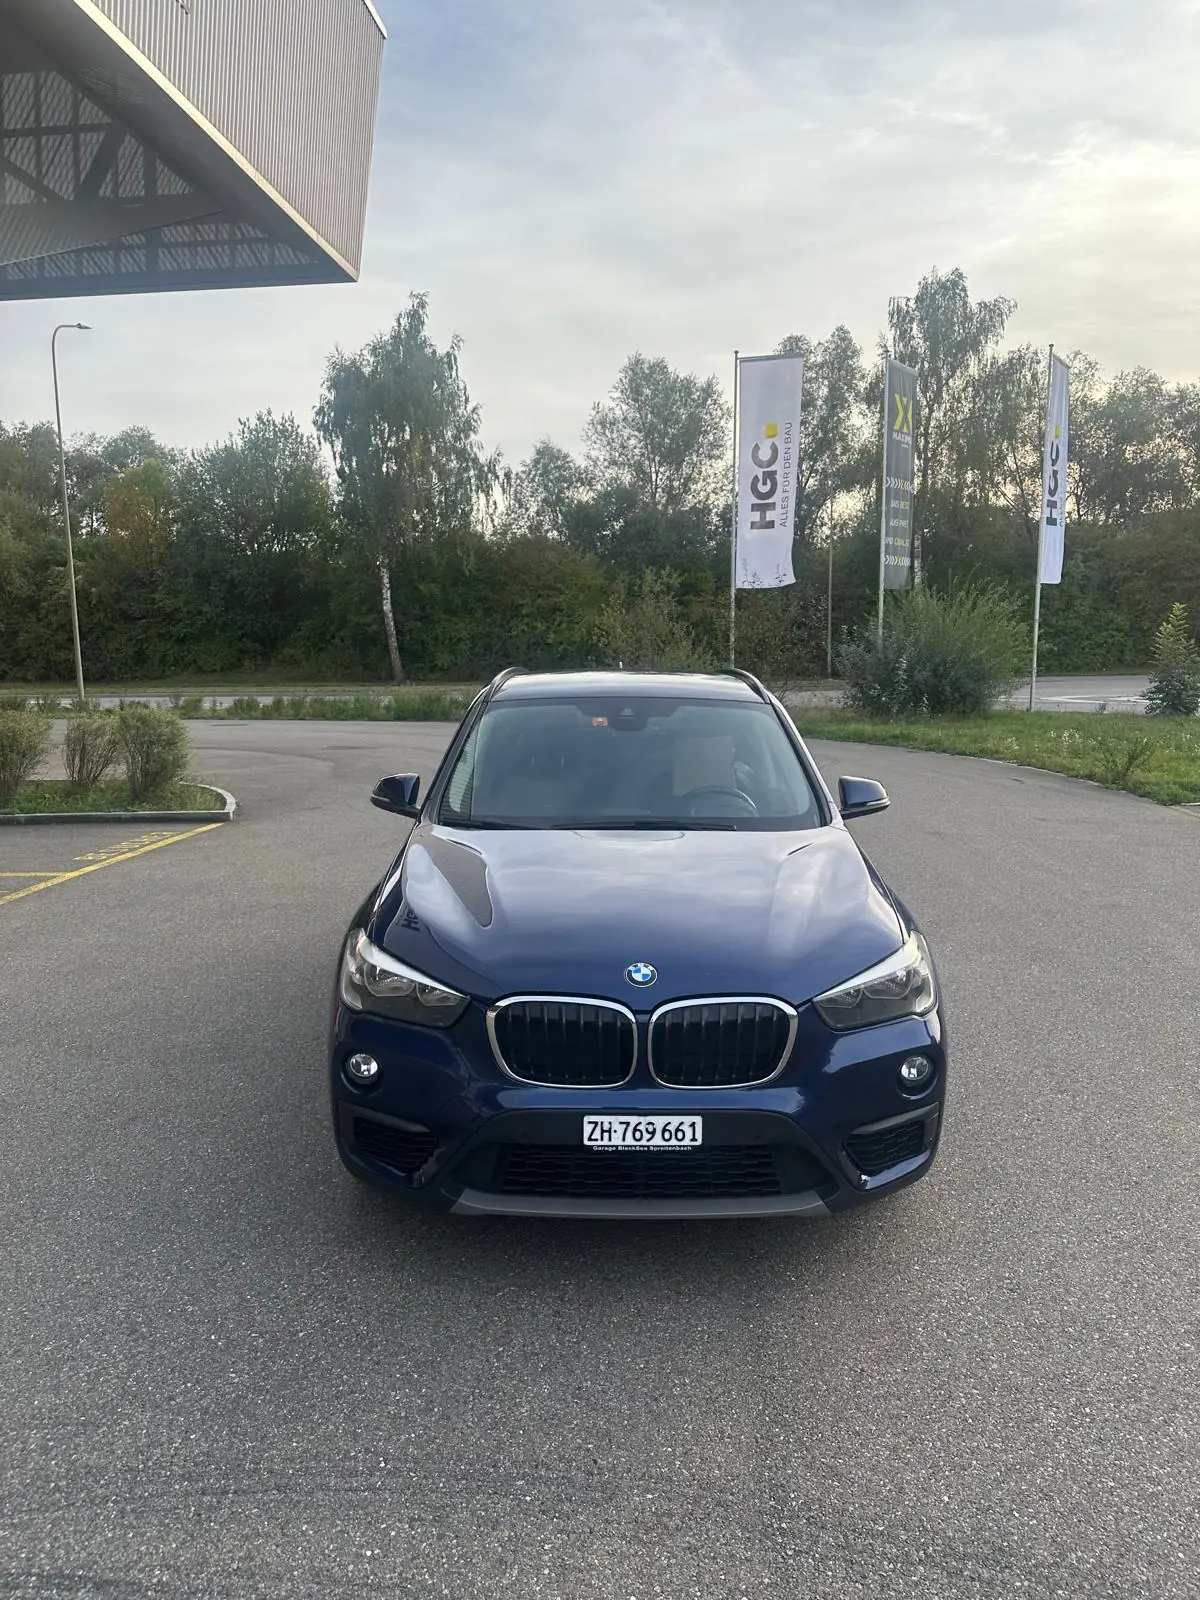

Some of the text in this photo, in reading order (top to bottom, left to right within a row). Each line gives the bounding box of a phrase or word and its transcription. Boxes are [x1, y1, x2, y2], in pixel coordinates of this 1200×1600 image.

[780, 422, 793, 527] ALLES FÜR DEN BAU
